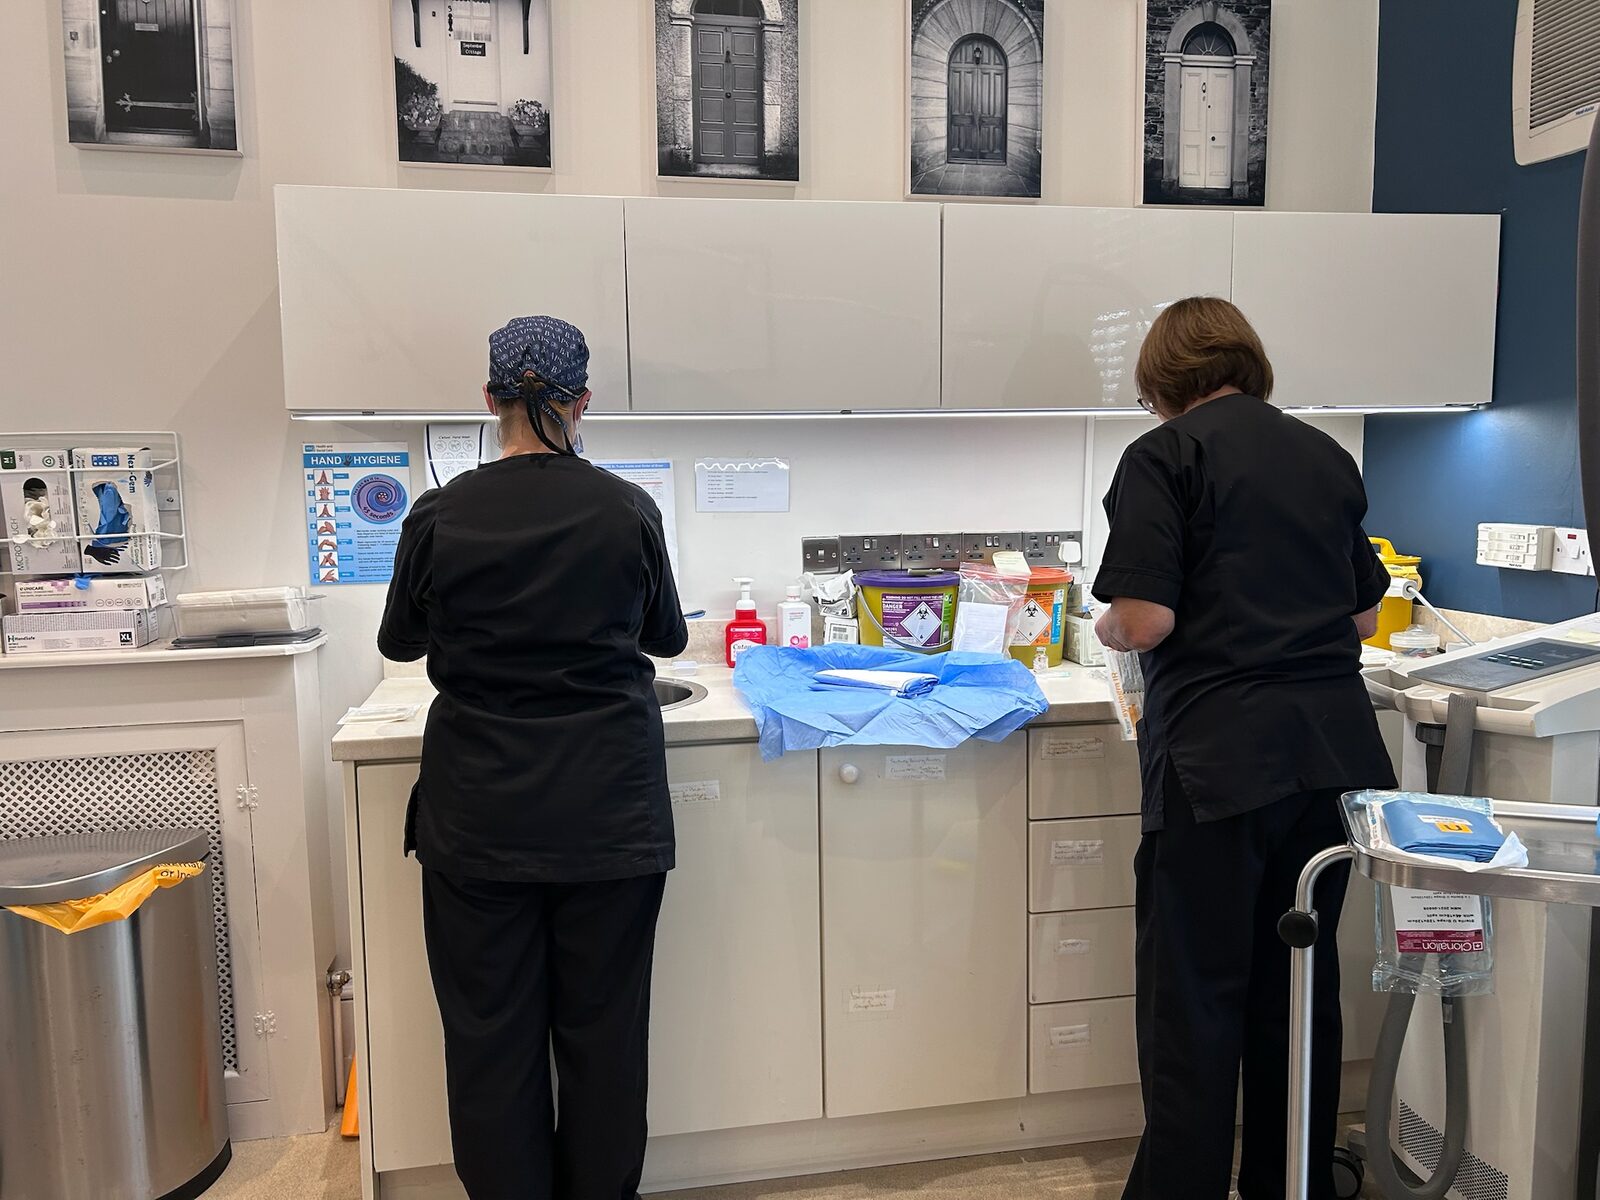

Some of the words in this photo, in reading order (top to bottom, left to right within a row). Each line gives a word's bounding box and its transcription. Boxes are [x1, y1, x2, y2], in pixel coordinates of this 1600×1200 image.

[311, 456, 342, 465] HAND
[353, 456, 401, 464] HYGIENE
[369, 511, 394, 520] seconds
[120, 633, 131, 641] XL
